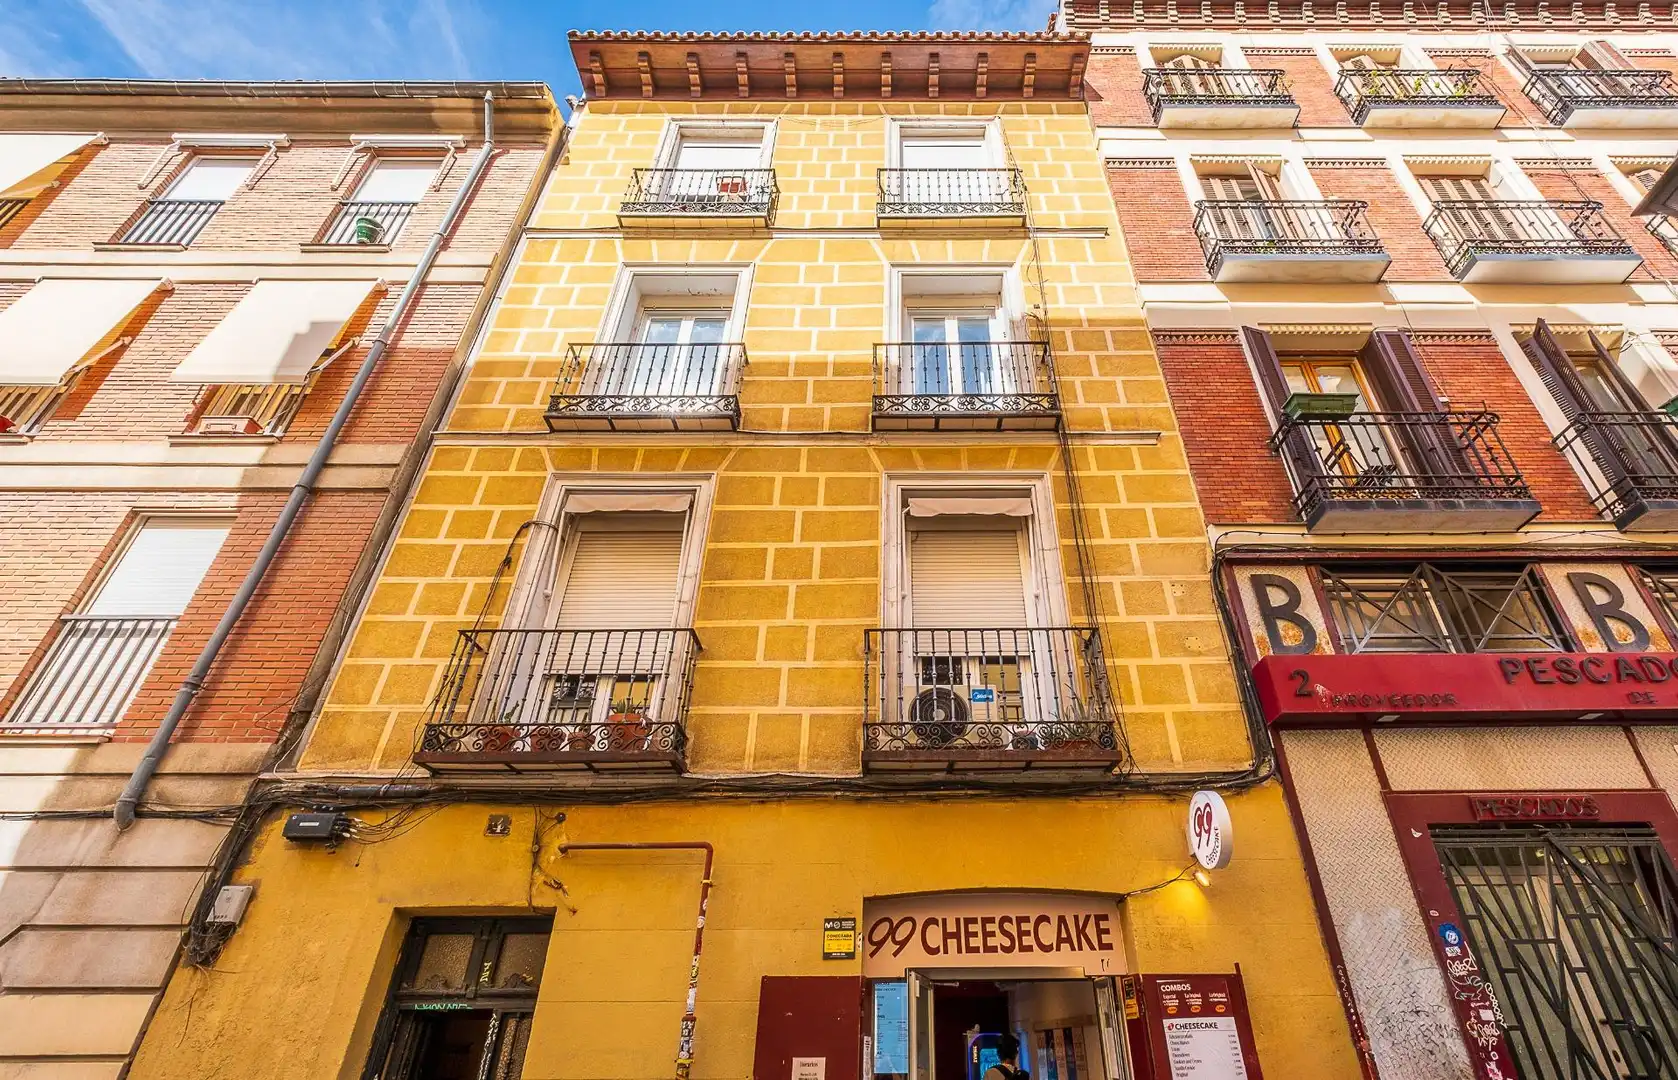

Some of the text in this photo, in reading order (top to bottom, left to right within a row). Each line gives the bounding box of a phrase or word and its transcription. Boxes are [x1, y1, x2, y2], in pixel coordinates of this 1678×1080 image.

[1250, 573, 1317, 655] B
[1567, 572, 1650, 652] B
[1288, 669, 1315, 698] 2
[1498, 655, 1678, 686] PESCAD
[1331, 691, 1657, 709] PROVEEDOR DE
[1476, 796, 1600, 818] PESCADOS
[1193, 802, 1213, 850] 99
[867, 913, 1115, 959] 99 CHEESECAKE
[1160, 983, 1192, 993] COMBOS
[1175, 1022, 1219, 1031] CHEESECAKE
